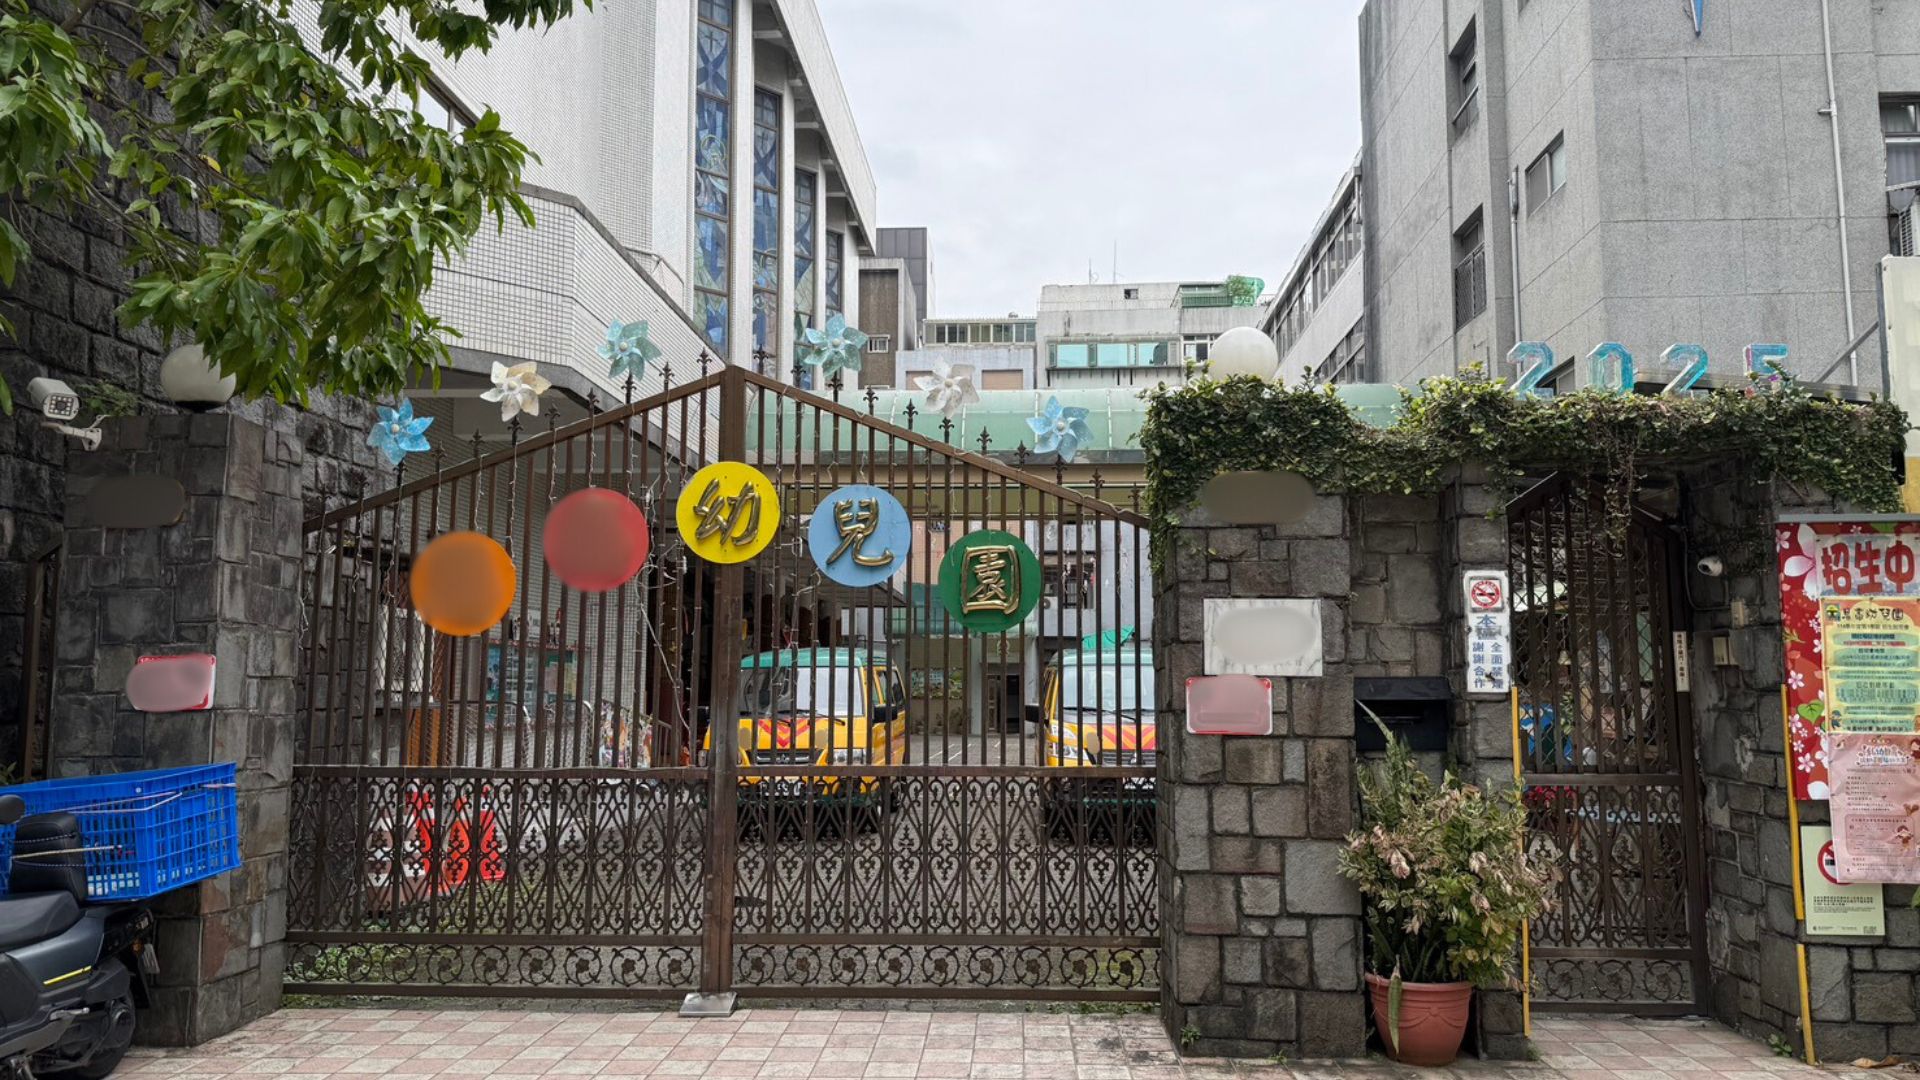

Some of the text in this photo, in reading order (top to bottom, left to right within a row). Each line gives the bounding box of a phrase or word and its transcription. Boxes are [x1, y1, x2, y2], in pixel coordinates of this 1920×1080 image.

[1506, 341, 1789, 399] 2025
[1821, 540, 1915, 595] 招生中
[1472, 642, 1486, 689] 謝謝合作
